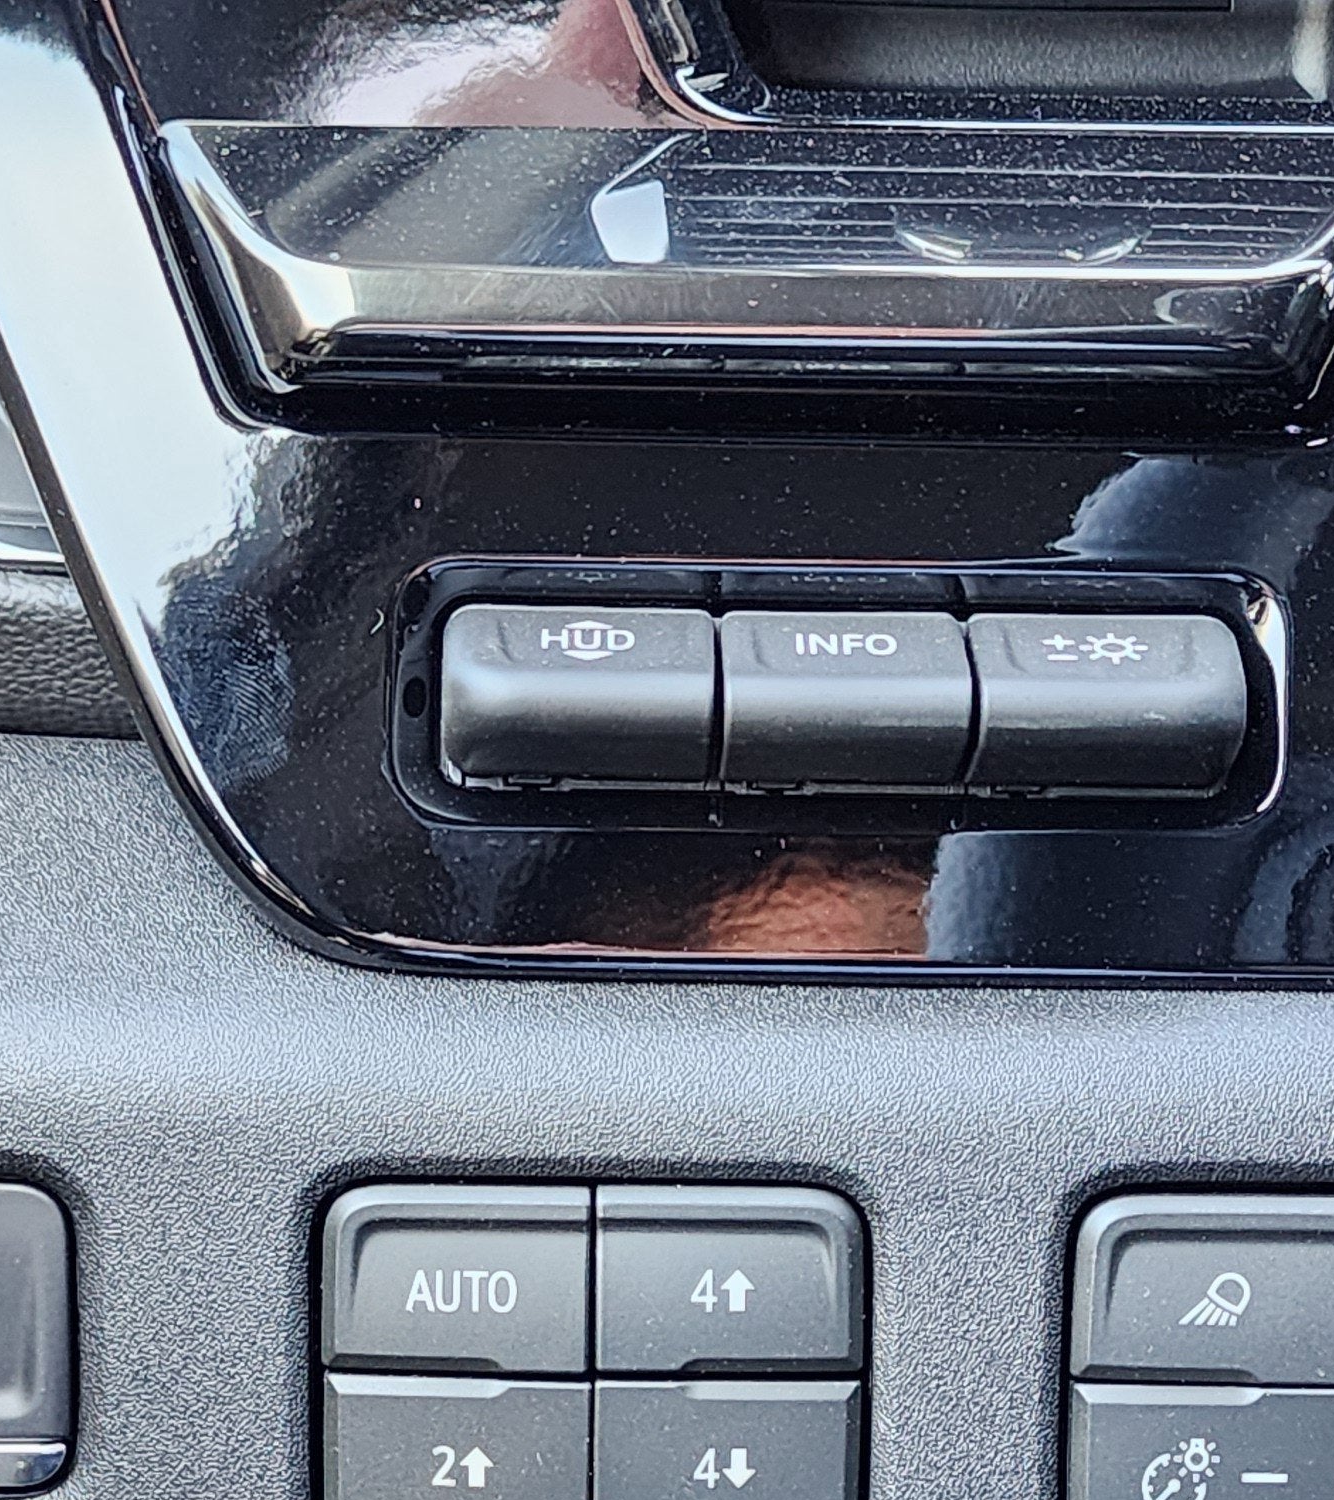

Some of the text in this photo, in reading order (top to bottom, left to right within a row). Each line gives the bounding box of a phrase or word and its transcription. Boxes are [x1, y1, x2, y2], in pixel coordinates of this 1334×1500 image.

[539, 626, 636, 652] HUD
[794, 632, 898, 656] INFO
[405, 1269, 518, 1314] AUTO
[690, 1268, 719, 1313] 4
[430, 1445, 458, 1488] 2
[692, 1447, 721, 1489] 4
